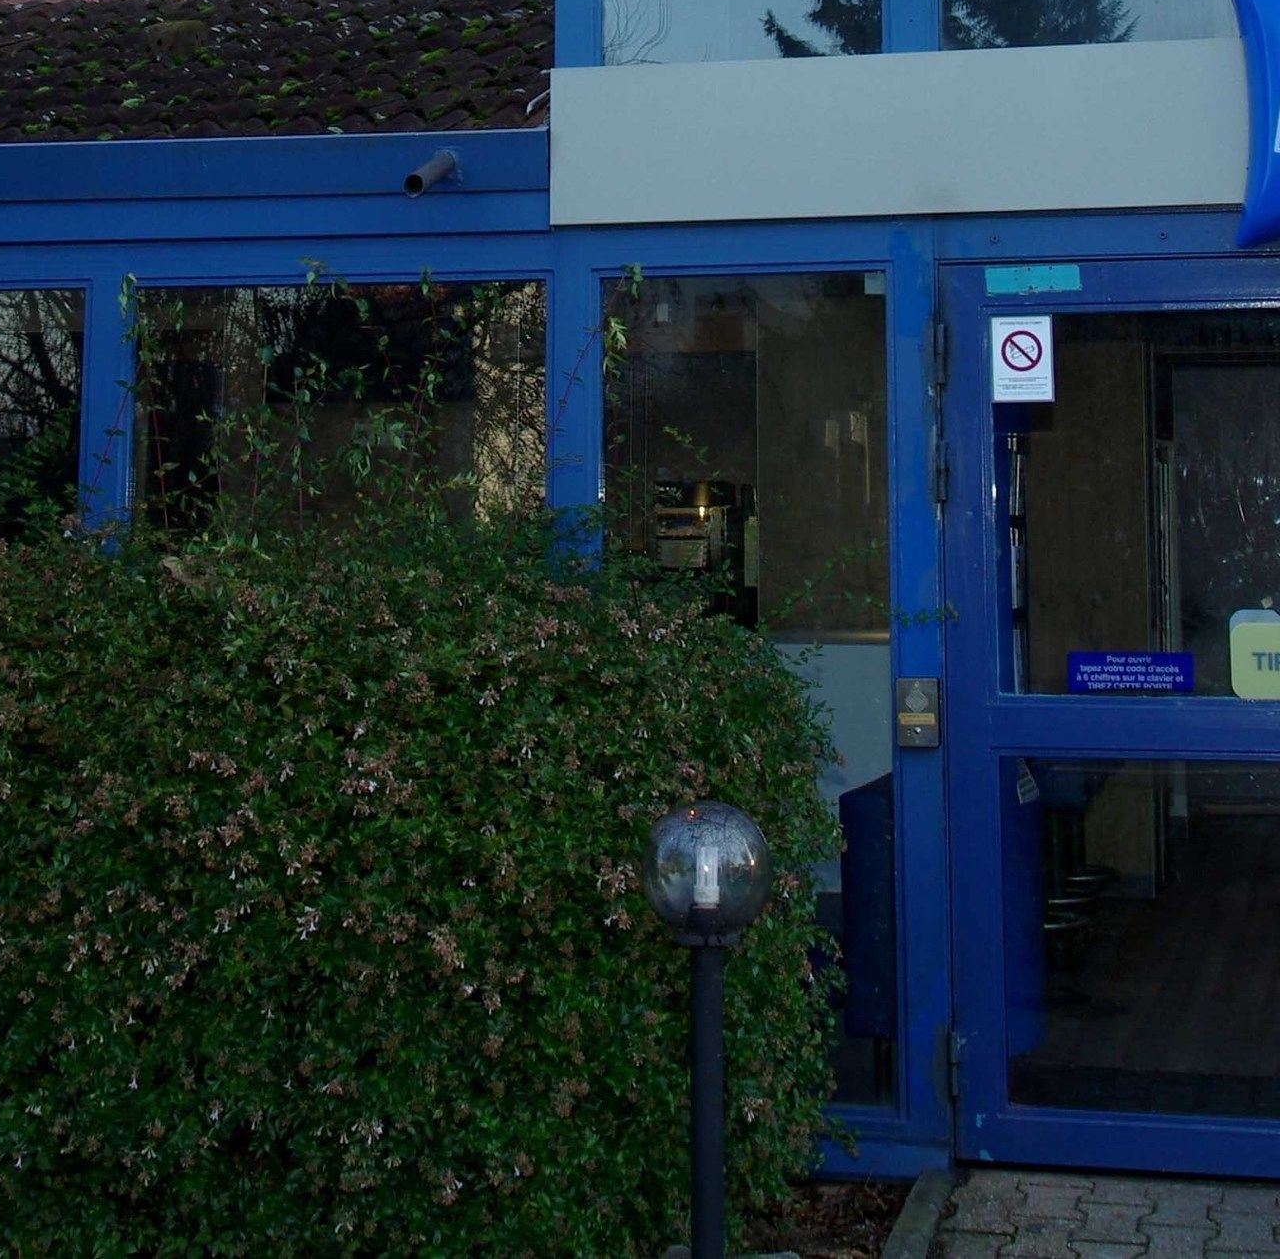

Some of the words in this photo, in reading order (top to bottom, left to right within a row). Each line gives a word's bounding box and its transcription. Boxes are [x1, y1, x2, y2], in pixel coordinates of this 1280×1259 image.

[1106, 655, 1126, 663] Pour
[1127, 655, 1152, 663] ouvrir
[1080, 665, 1102, 673] tapez
[1148, 665, 1180, 673] d'accès
[1090, 673, 1121, 682] chiffres
[1146, 673, 1174, 681] clavier
[1175, 674, 1184, 682] et
